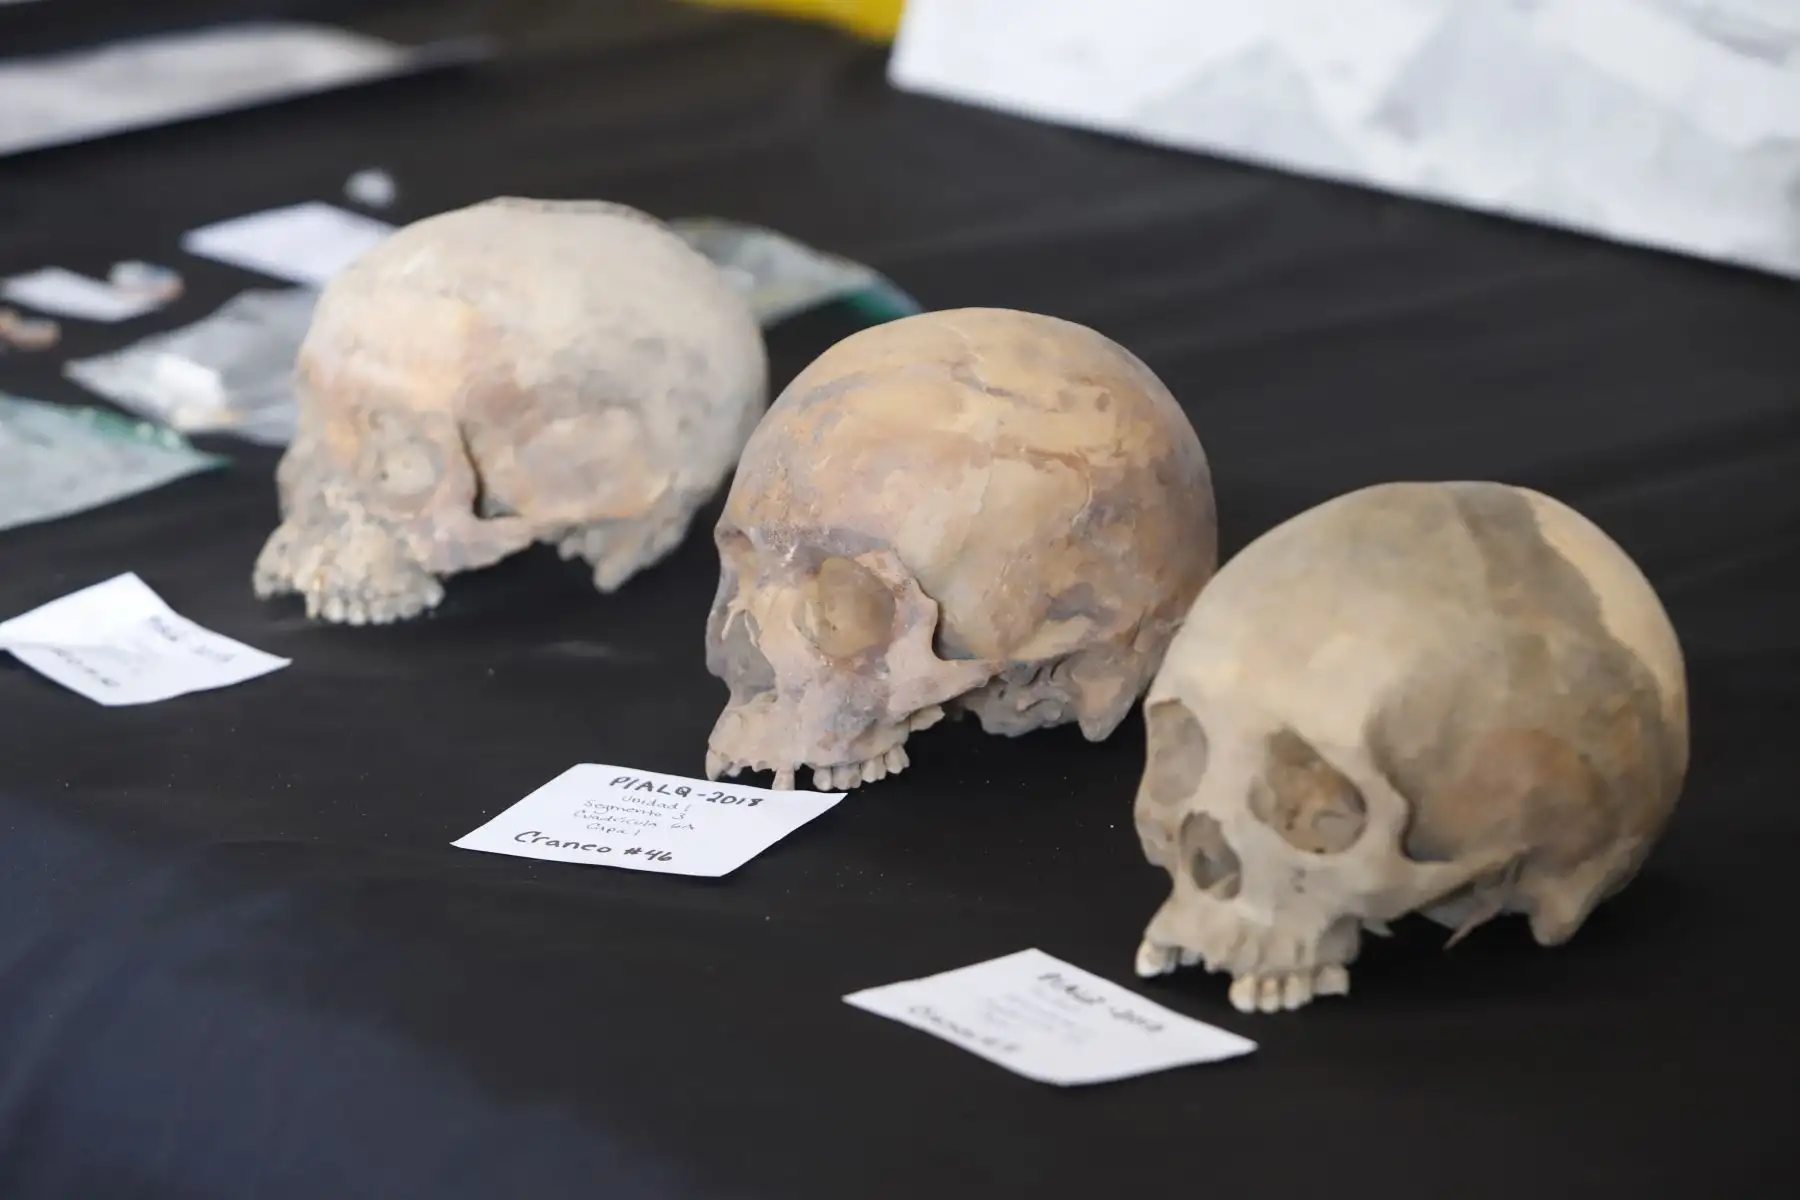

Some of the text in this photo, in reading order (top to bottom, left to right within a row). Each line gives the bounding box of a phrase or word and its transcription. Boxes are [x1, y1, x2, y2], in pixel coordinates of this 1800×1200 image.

[583, 799, 662, 818] Segmento
[622, 795, 679, 810] Unidad
[586, 822, 628, 835] Capa
[624, 847, 673, 862] #46
